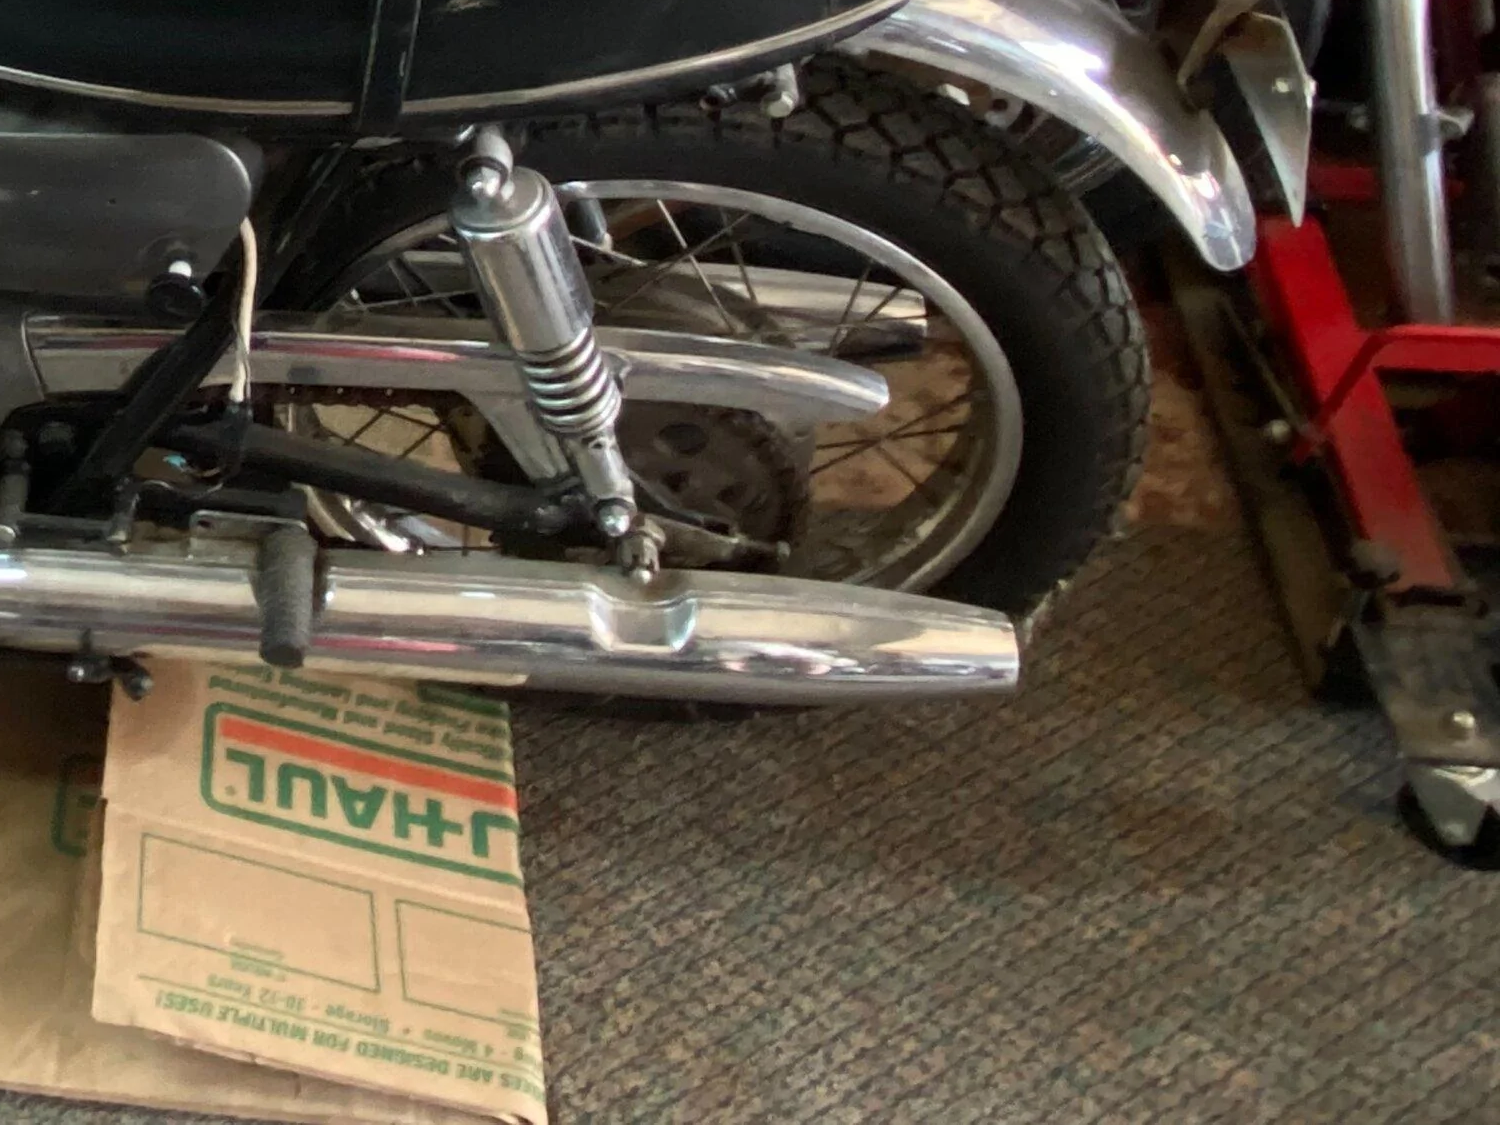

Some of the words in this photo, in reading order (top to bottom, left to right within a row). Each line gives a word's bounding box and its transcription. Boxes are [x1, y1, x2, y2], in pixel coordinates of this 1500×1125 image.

[155, 989, 213, 1019] USES!
[325, 1003, 390, 1034] Storage
[216, 1001, 307, 1043] MULTIPLE
[311, 1028, 351, 1053] FOR
[355, 1039, 450, 1075] DESIGNED
[454, 1063, 495, 1083] ARE
